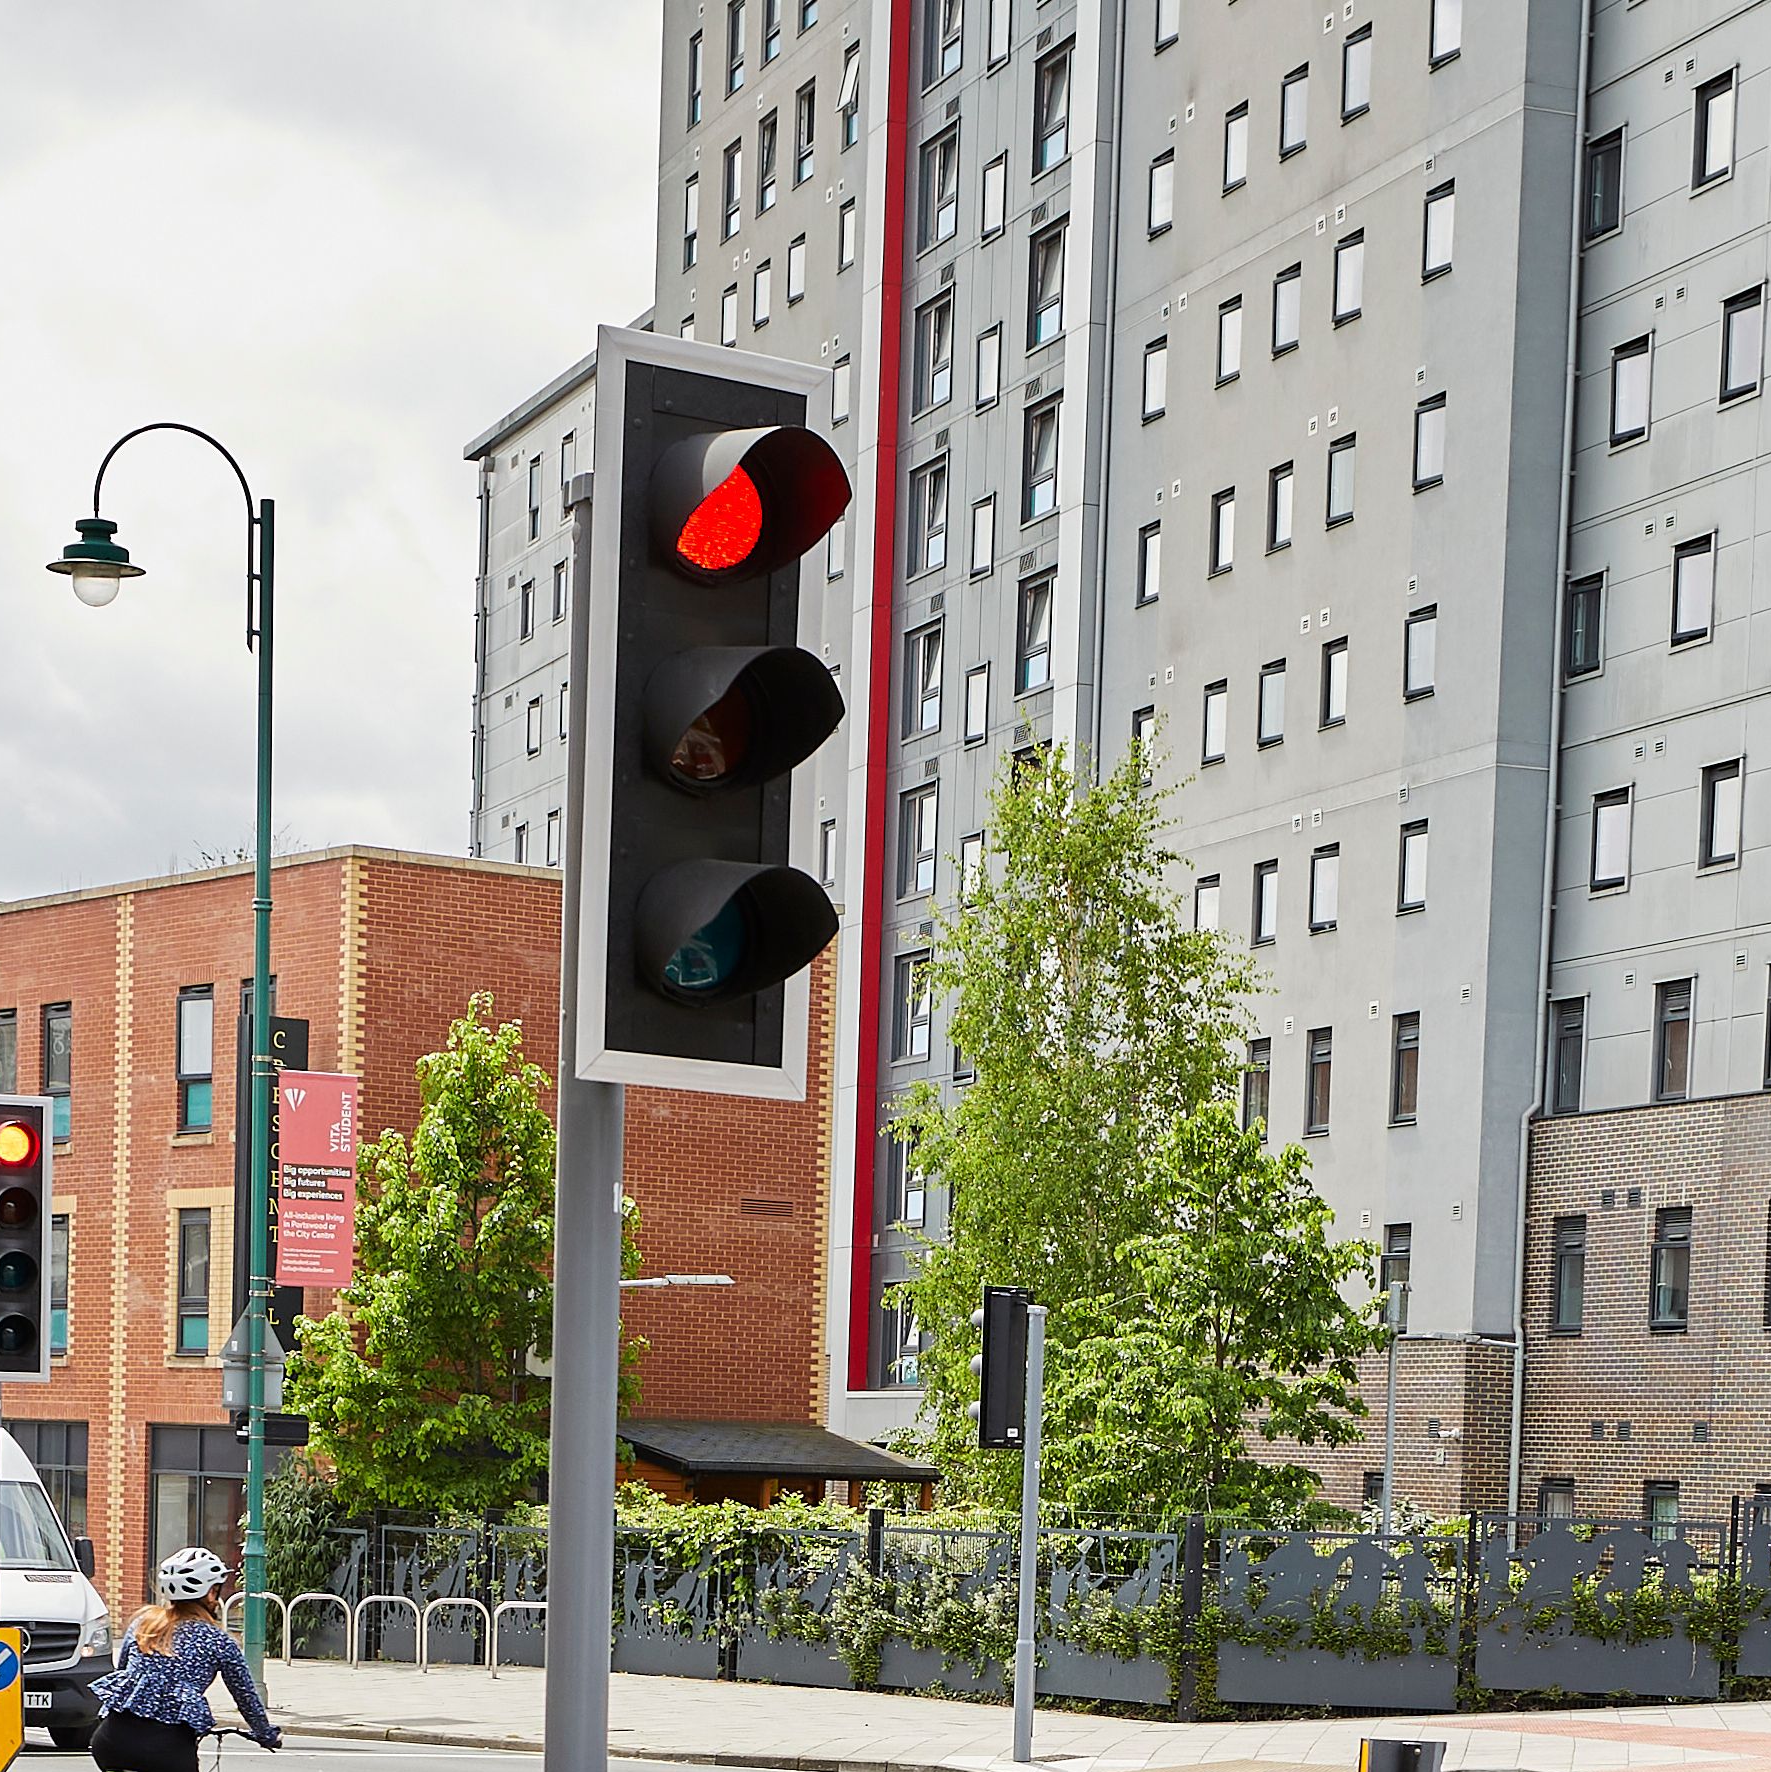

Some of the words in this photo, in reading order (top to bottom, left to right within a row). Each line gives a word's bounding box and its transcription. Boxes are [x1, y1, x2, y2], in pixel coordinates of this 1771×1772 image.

[341, 1092, 352, 1152] STUDENT
[330, 1122, 340, 1152] VITA
[283, 1165, 296, 1175] Big
[297, 1167, 351, 1177] opportunities
[283, 1177, 296, 1187] Big
[297, 1177, 326, 1187] futures
[283, 1188, 296, 1199] Big
[297, 1190, 344, 1200] experiences
[283, 1211, 325, 1221] All-inclusive
[325, 1213, 345, 1223] living
[296, 1230, 310, 1239] City
[311, 1231, 335, 1239] Centre
[26, 1694, 50, 1706] TTK
